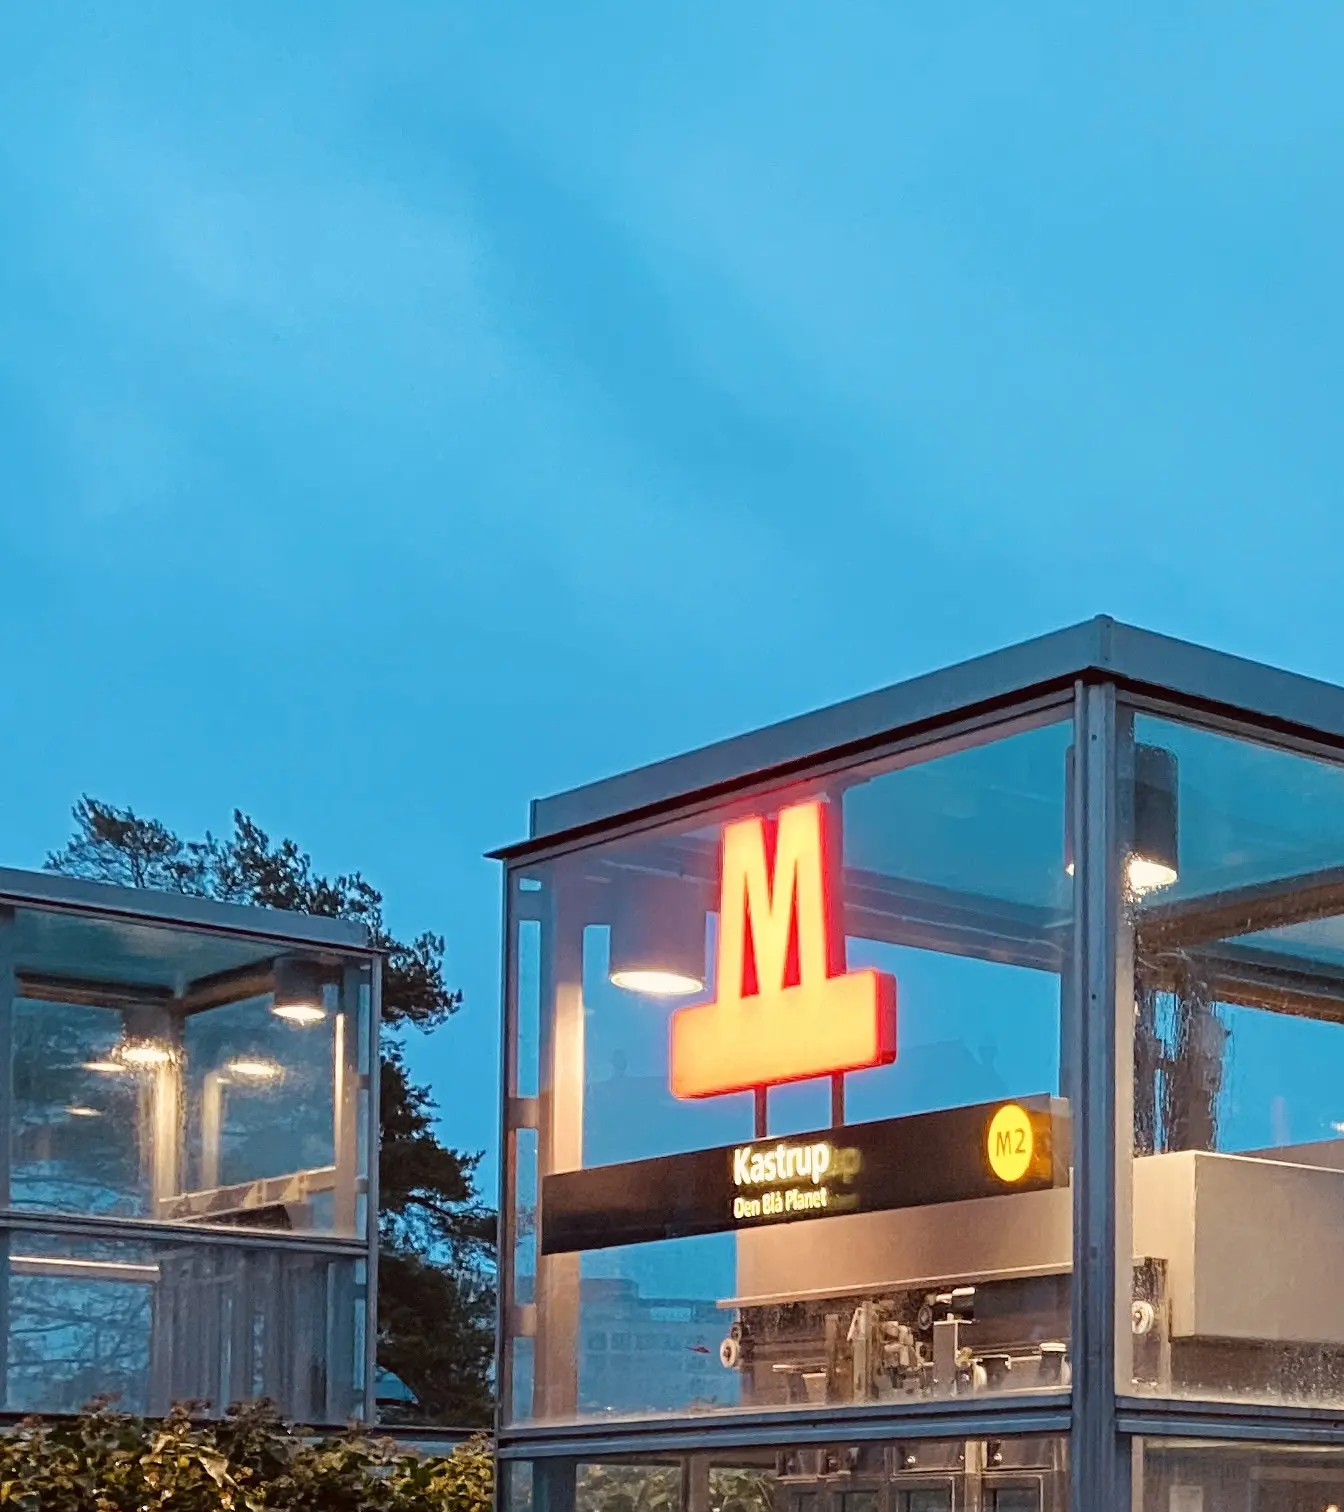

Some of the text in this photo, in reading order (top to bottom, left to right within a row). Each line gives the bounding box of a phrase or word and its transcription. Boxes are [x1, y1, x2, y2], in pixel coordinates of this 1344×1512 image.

[995, 1127, 1026, 1157] M2
[733, 1143, 831, 1186] Kastrup
[733, 1197, 761, 1219] Den
[785, 1187, 827, 1212] Planet
